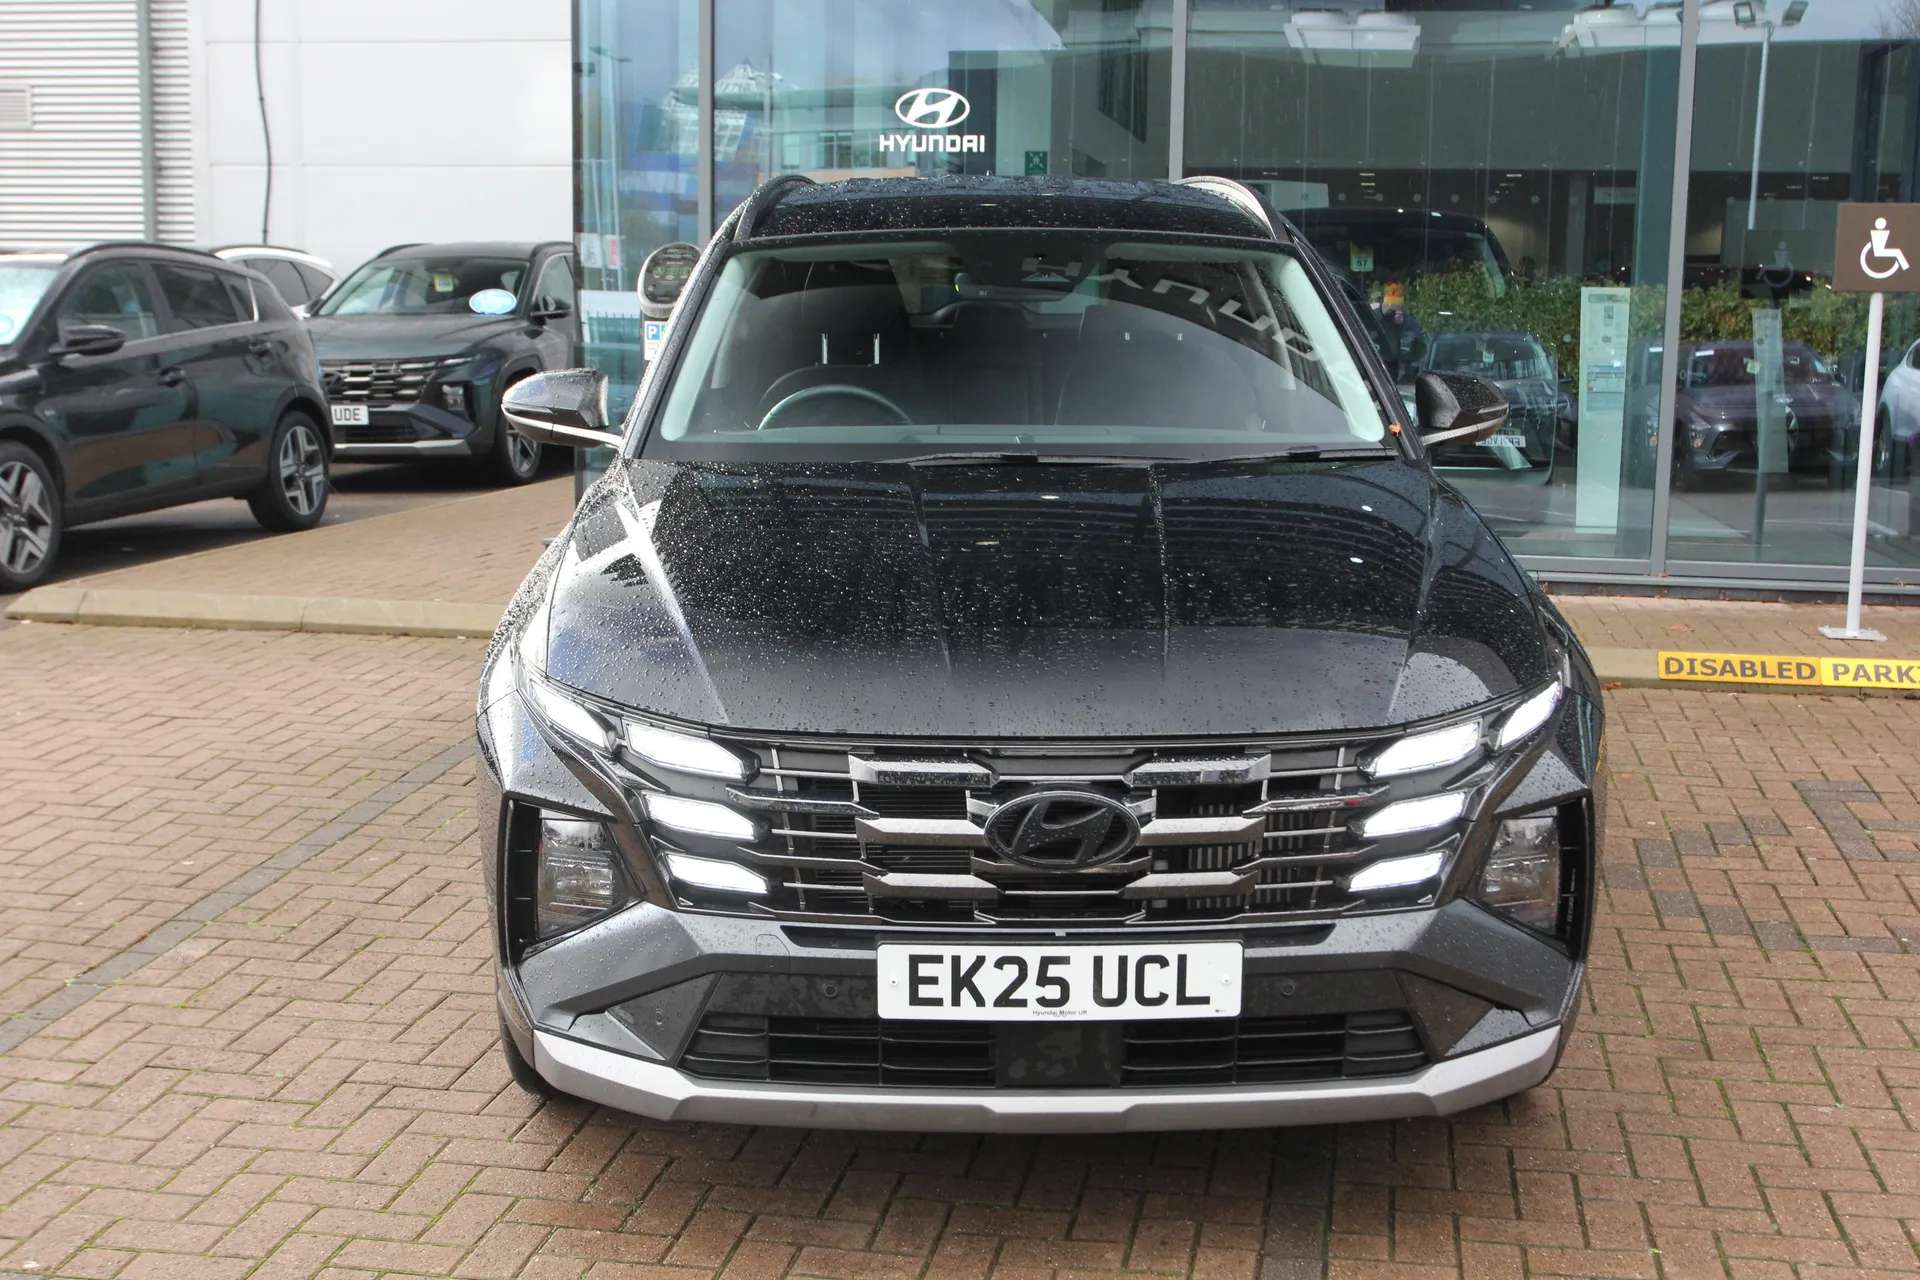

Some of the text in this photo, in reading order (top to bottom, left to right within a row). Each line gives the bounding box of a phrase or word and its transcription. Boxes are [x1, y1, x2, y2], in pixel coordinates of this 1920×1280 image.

[879, 134, 986, 153] HYUNDAI
[334, 407, 361, 421] UDE
[1664, 656, 1920, 684] DISABLED PARK
[908, 953, 1210, 1008] EK25 UCL
